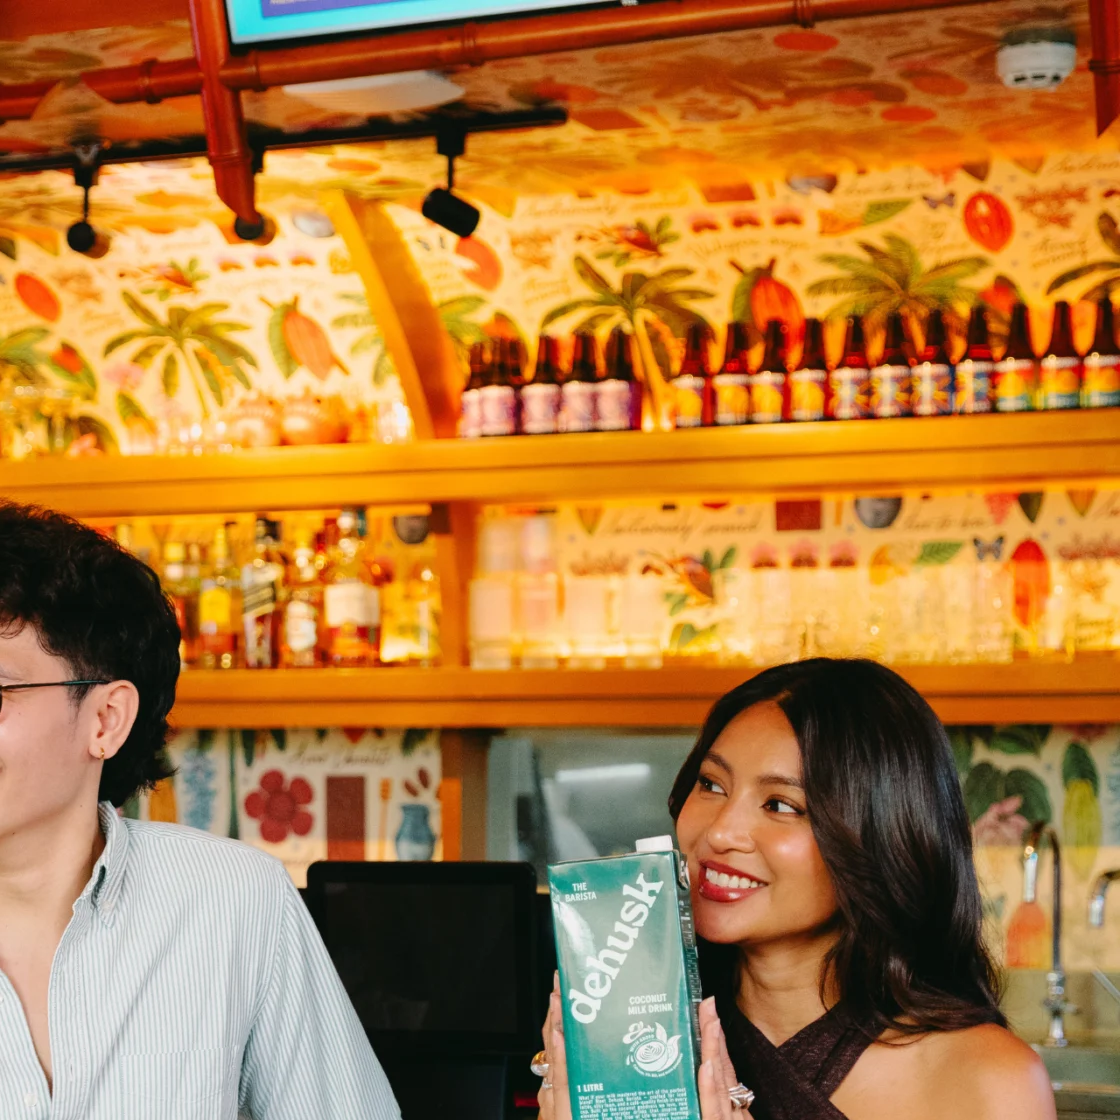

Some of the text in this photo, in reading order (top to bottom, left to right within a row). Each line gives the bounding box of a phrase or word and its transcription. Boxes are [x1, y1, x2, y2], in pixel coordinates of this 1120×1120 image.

[572, 882, 588, 892] THE
[564, 892, 597, 902] BARISTA
[568, 872, 664, 1024] dehusk
[629, 993, 667, 1005] COCONUT
[628, 1002, 673, 1016] MILK DRINK
[584, 1083, 604, 1092] LITRE
